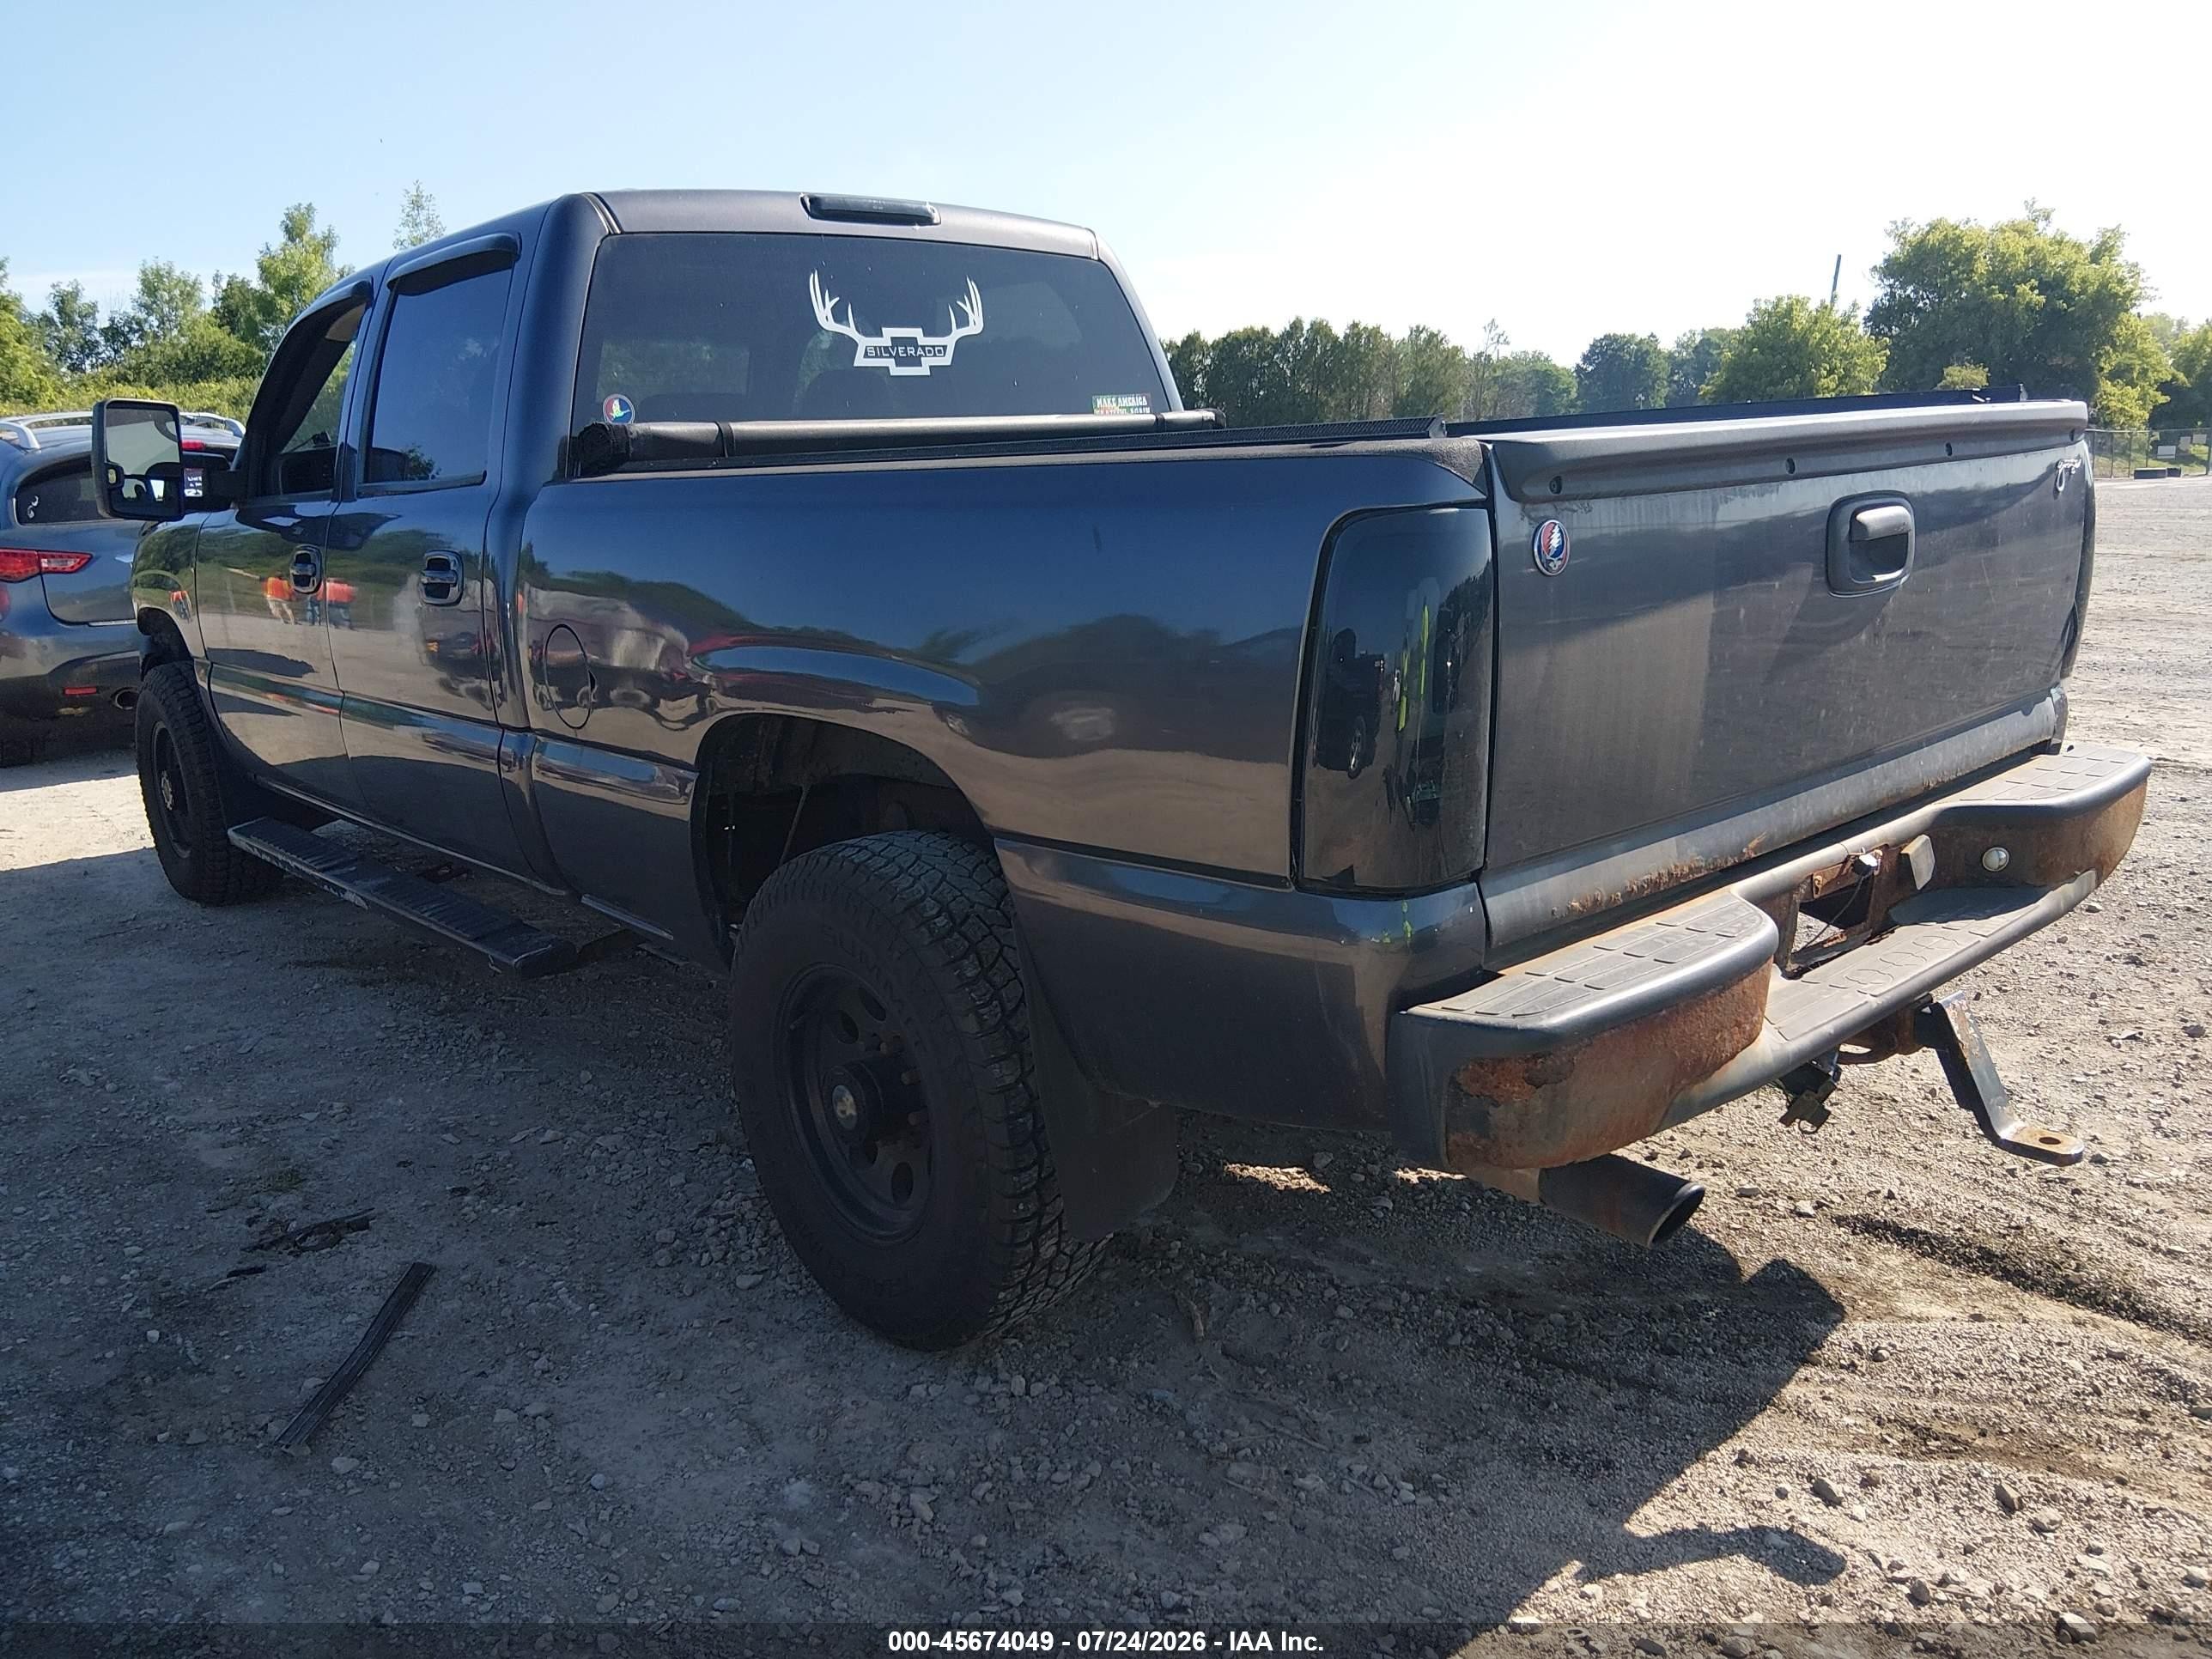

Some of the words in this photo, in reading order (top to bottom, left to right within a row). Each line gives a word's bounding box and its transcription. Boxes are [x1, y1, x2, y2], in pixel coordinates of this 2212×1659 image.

[866, 346, 945, 357] SILVERADO
[1097, 398, 1116, 408] MAKE
[1118, 396, 1148, 406] AMERICA
